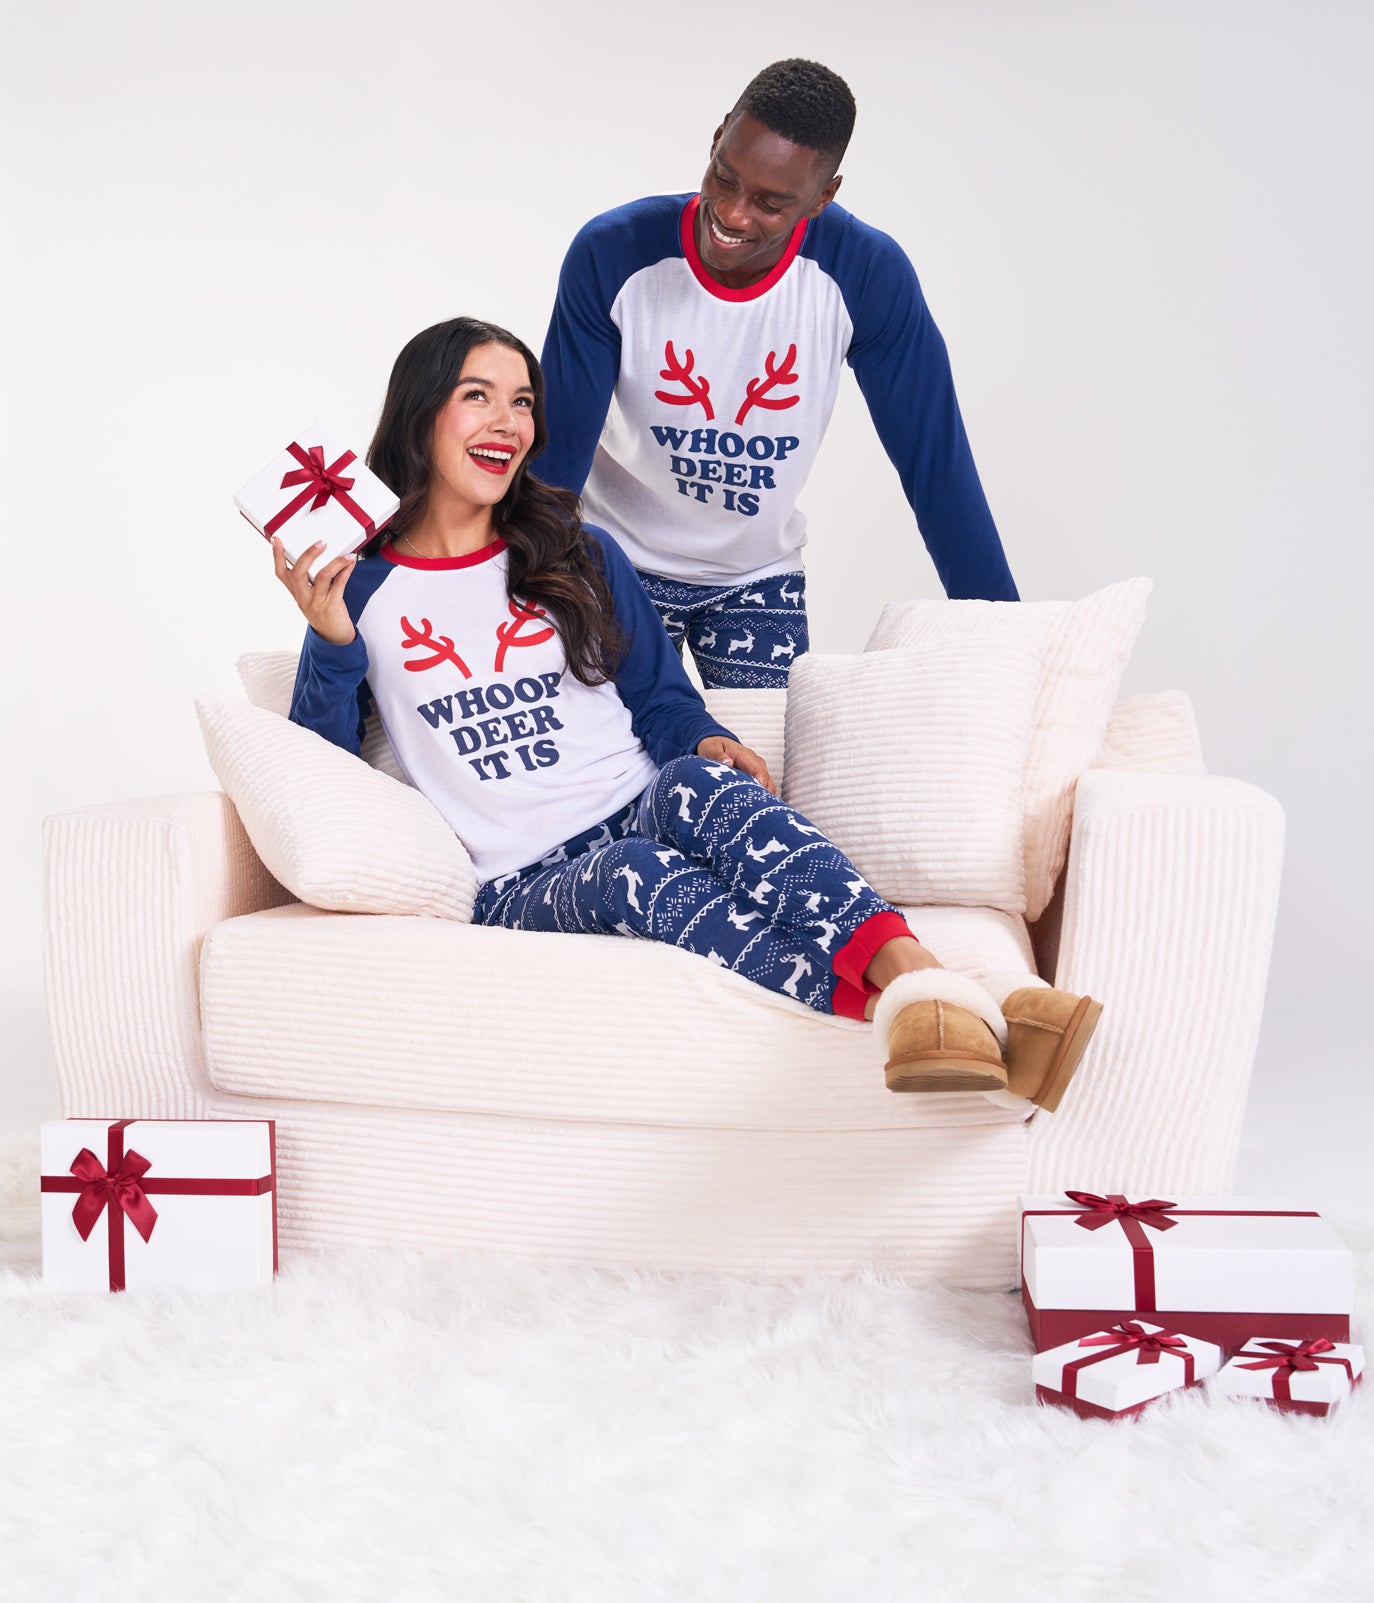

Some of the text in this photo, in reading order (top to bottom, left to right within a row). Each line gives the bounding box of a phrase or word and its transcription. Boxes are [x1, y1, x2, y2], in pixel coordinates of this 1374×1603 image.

[649, 425, 800, 461] WHOOP
[669, 454, 777, 490] DEER
[675, 478, 760, 517] IT IS
[416, 672, 562, 730] WHOOP
[449, 705, 565, 756] DEER
[468, 739, 560, 781] IT IS
